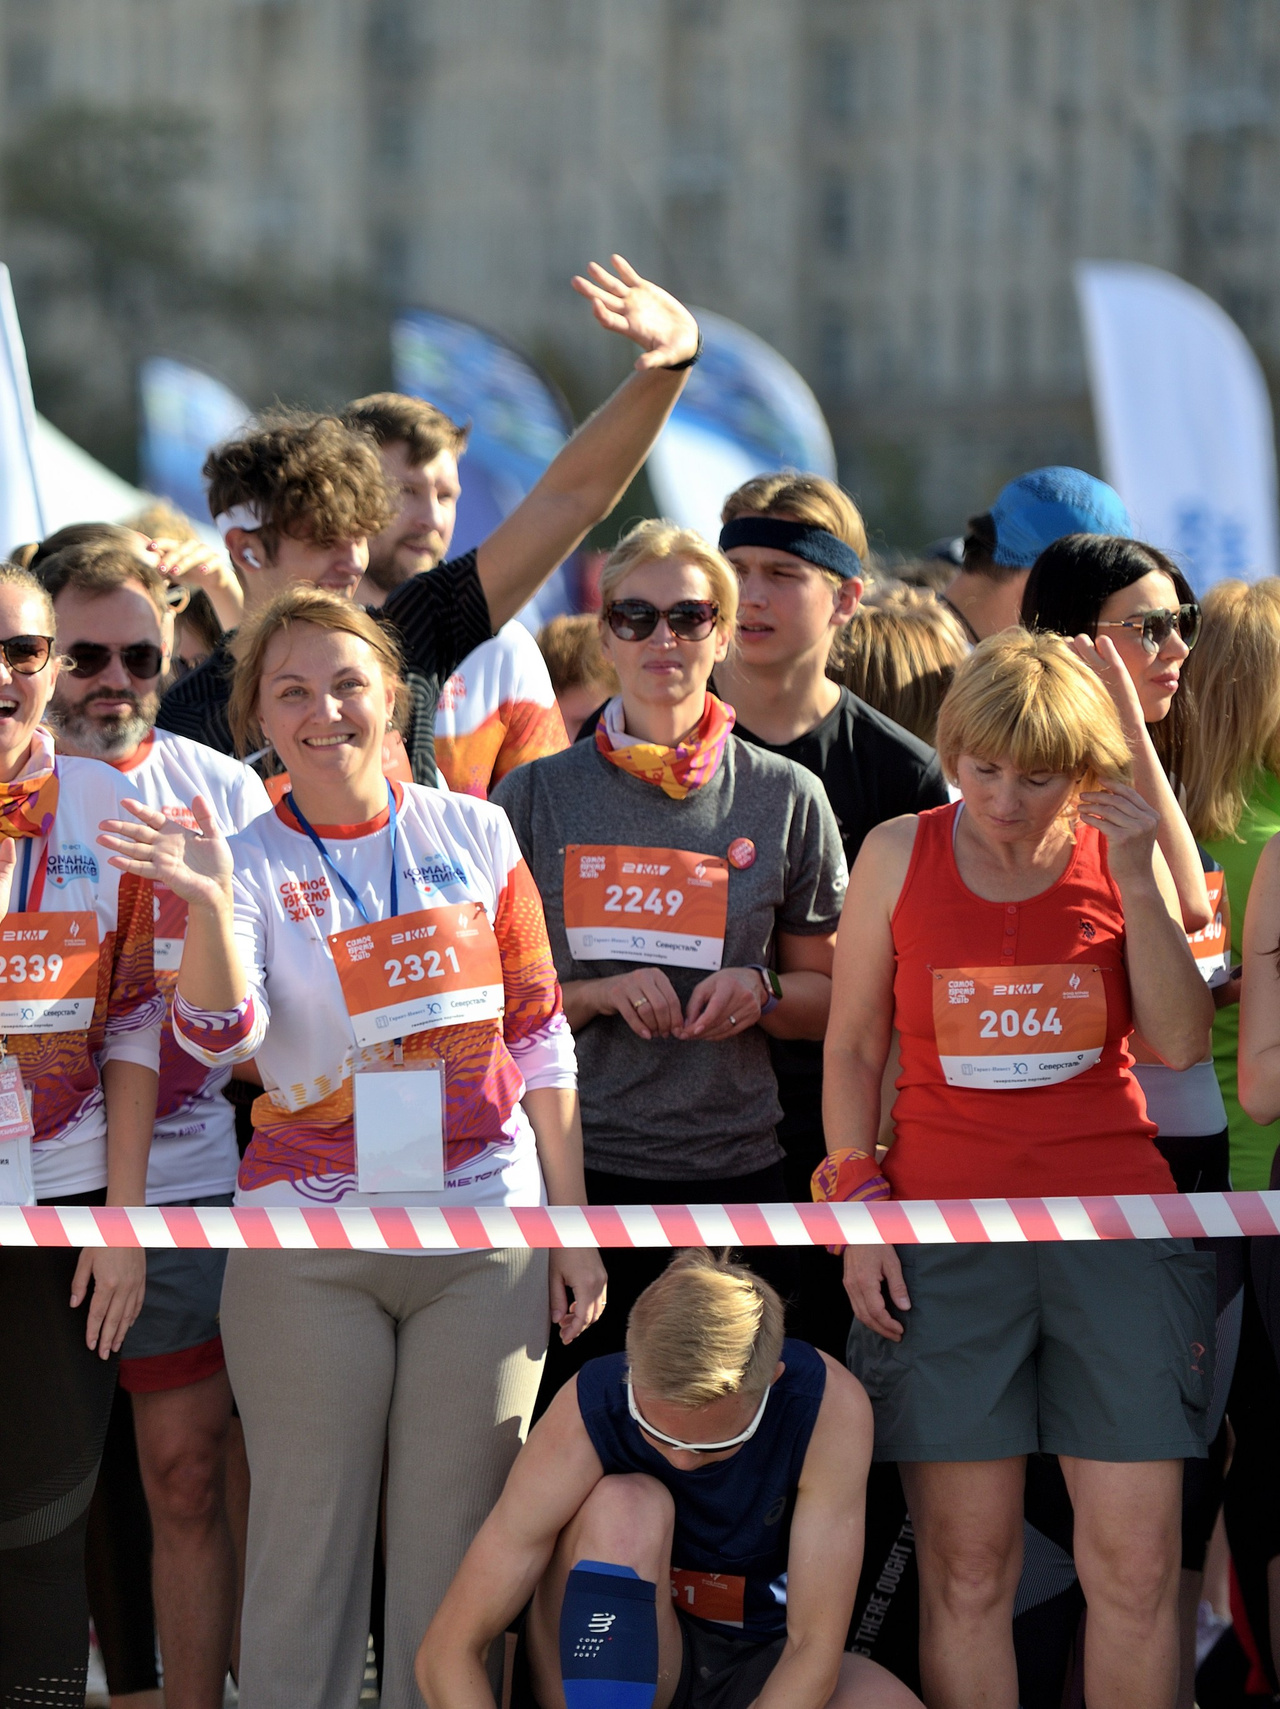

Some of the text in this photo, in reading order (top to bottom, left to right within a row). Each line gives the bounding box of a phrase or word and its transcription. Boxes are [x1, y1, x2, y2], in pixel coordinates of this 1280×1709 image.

[604, 884, 684, 916] 2249
[656, 940, 698, 952] Северсталь
[384, 946, 461, 988] 2321
[43, 1009, 76, 1018] Северсталь
[450, 998, 486, 1009] Северсталь
[979, 1007, 1063, 1038] 2064
[1039, 1061, 1081, 1071] Северсталь
[855, 1592, 891, 1642] THERE
[876, 1541, 912, 1595] OUGHT
